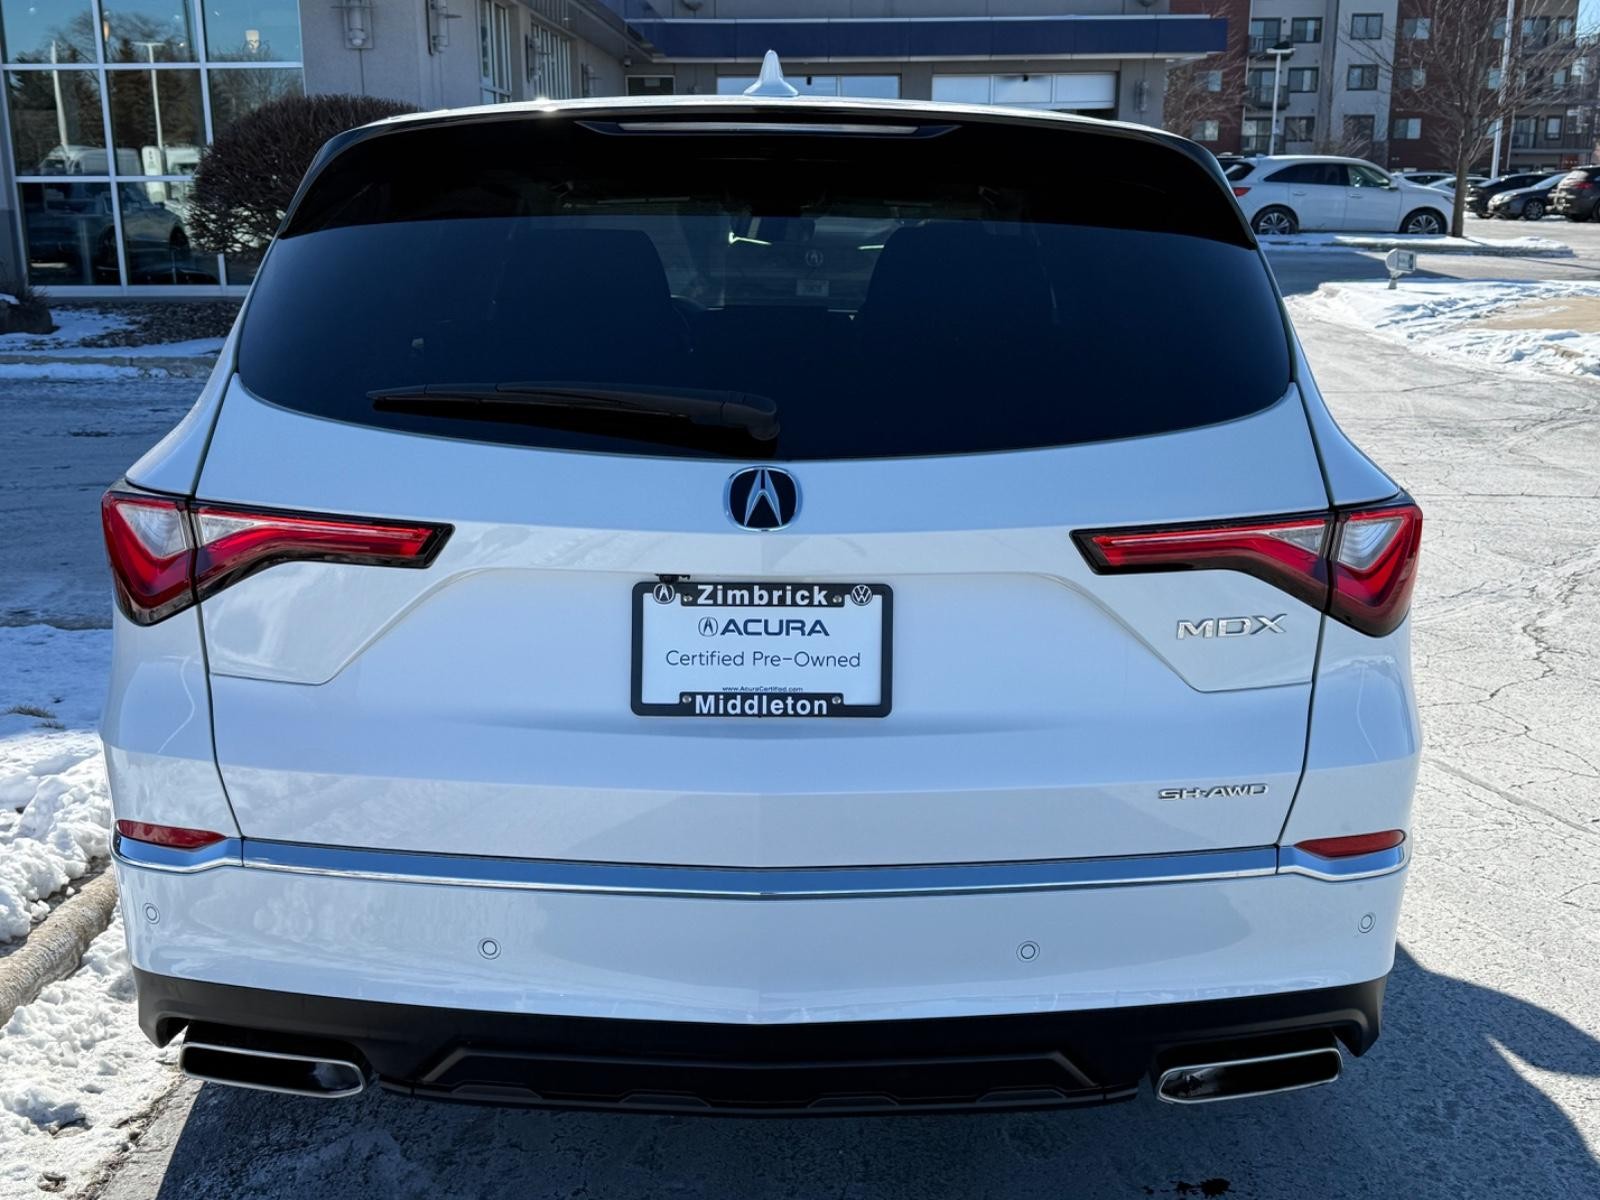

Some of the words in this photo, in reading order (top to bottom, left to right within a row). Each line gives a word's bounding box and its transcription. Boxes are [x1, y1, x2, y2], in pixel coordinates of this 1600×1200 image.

[697, 585, 828, 605] Zimbrick
[720, 618, 830, 637] ACURA
[1176, 613, 1288, 640] MDX
[665, 650, 745, 667] Certified
[752, 651, 861, 668] Pre-Owned
[695, 695, 828, 715] Middleton
[1158, 783, 1270, 800] SH-AWD
